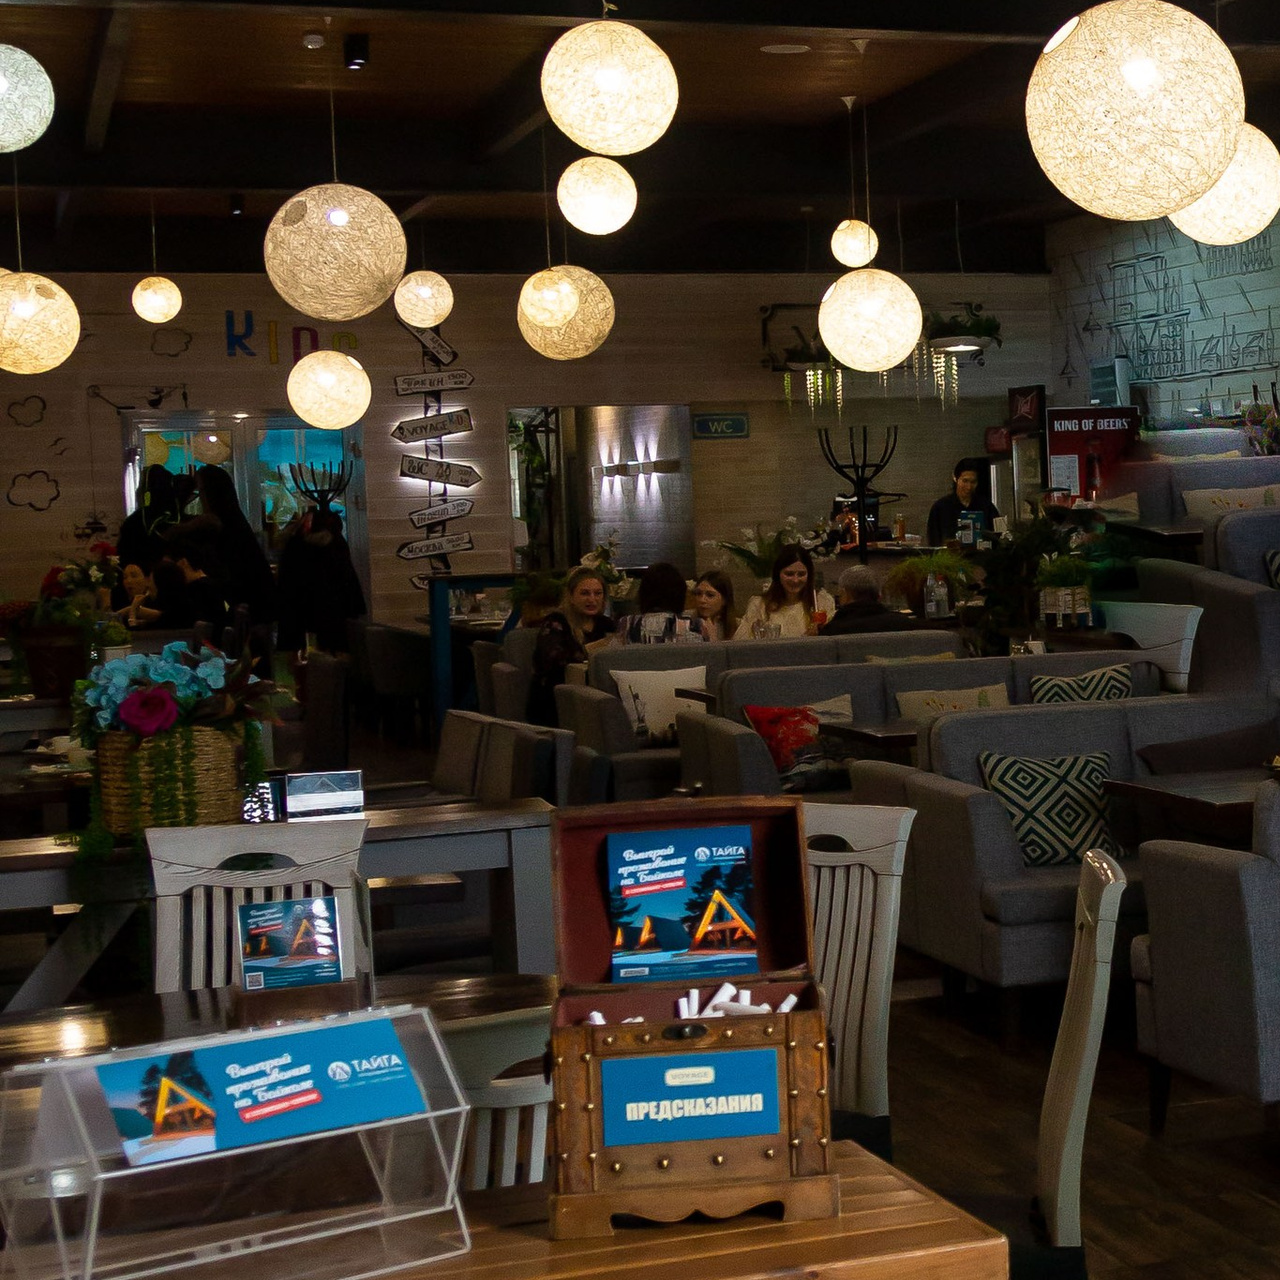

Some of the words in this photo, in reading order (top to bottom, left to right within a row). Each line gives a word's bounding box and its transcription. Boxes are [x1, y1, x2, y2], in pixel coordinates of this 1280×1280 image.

[405, 420, 448, 436] VOYAGE
[708, 421, 733, 433] WC
[1054, 420, 1079, 432] KING
[1081, 419, 1095, 431] OF
[1096, 418, 1129, 430] BEERS
[711, 845, 746, 857] ТАЙГА
[351, 1053, 403, 1073] ТАЙГА
[625, 1093, 764, 1122] ПРЕДСКАЗАНИЯ
